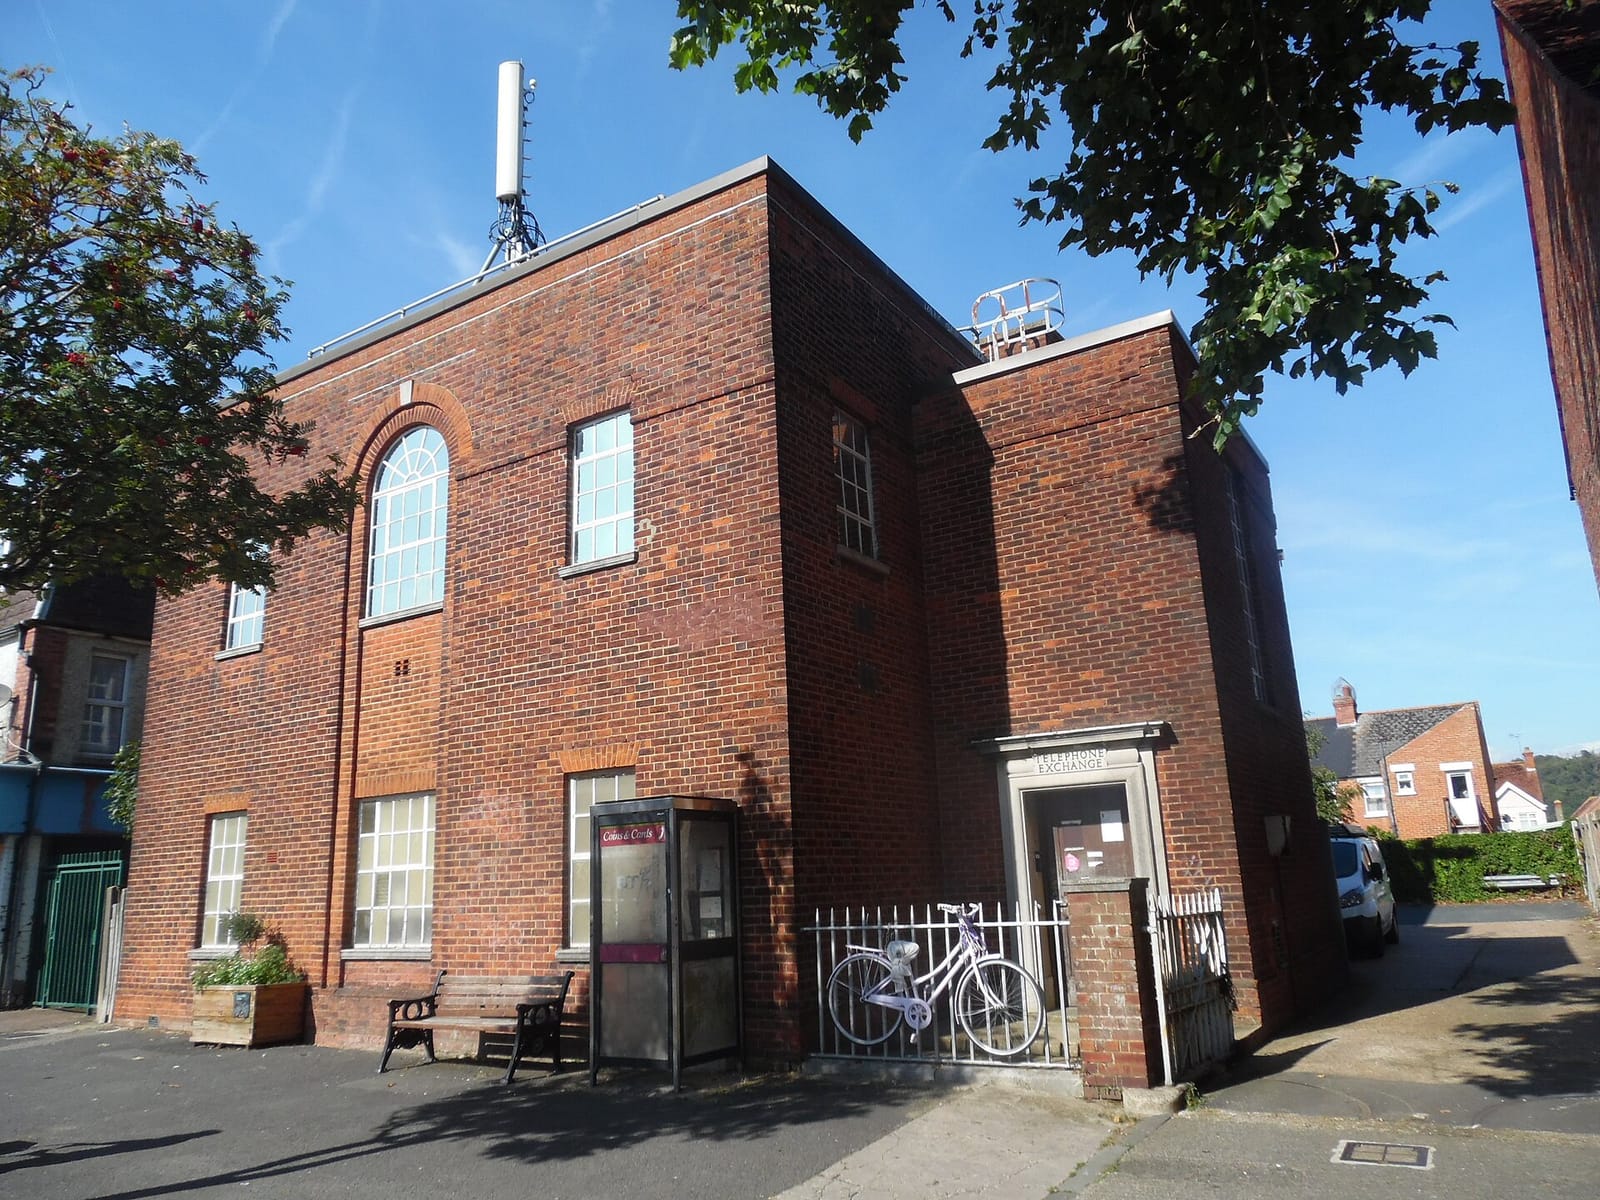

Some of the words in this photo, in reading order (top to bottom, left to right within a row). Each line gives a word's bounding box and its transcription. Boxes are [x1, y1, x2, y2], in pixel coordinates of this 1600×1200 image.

[1035, 749, 1105, 764] TELEPHONE
[1039, 758, 1103, 774] EXCHANGE
[603, 830, 622, 842] Coins
[631, 828, 653, 840] Cards
